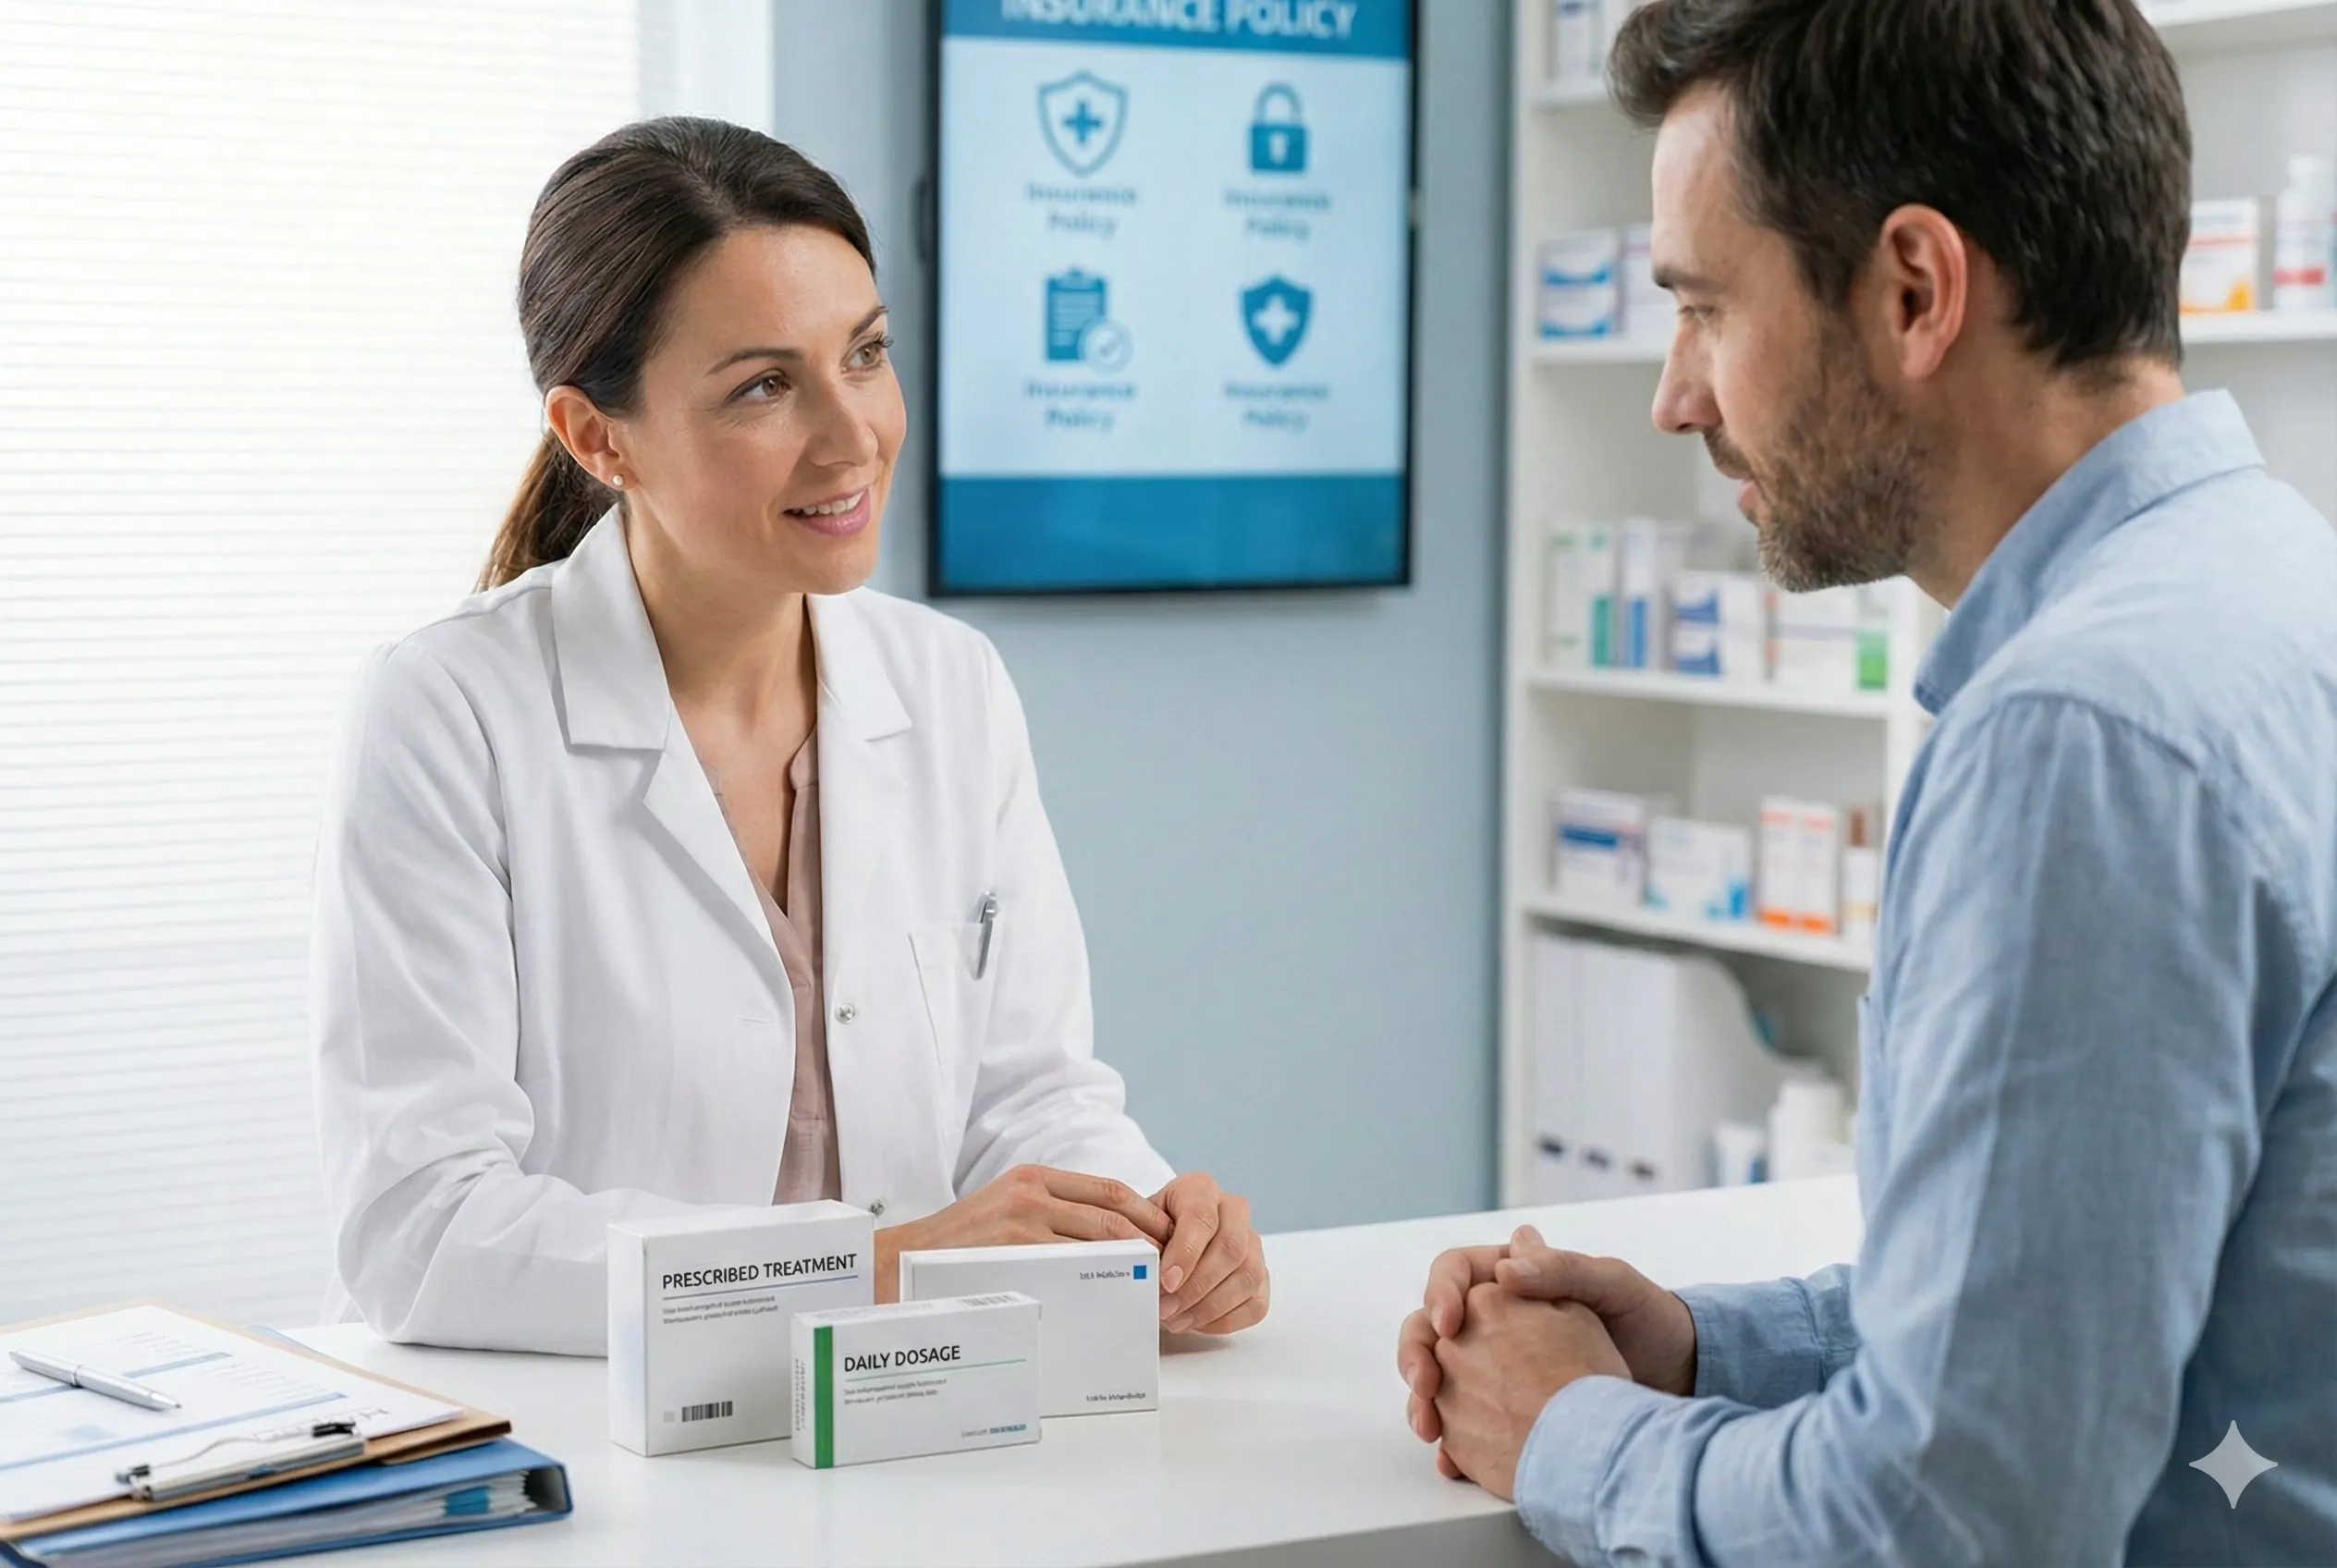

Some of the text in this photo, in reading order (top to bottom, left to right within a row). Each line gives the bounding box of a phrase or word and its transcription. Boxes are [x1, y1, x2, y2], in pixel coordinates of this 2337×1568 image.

[1002, 0, 1358, 40] INSURANCE POLICY
[662, 1253, 858, 1290] PRESCRIBED TREATMENT
[844, 1344, 961, 1372] DAILY DOSAGE
